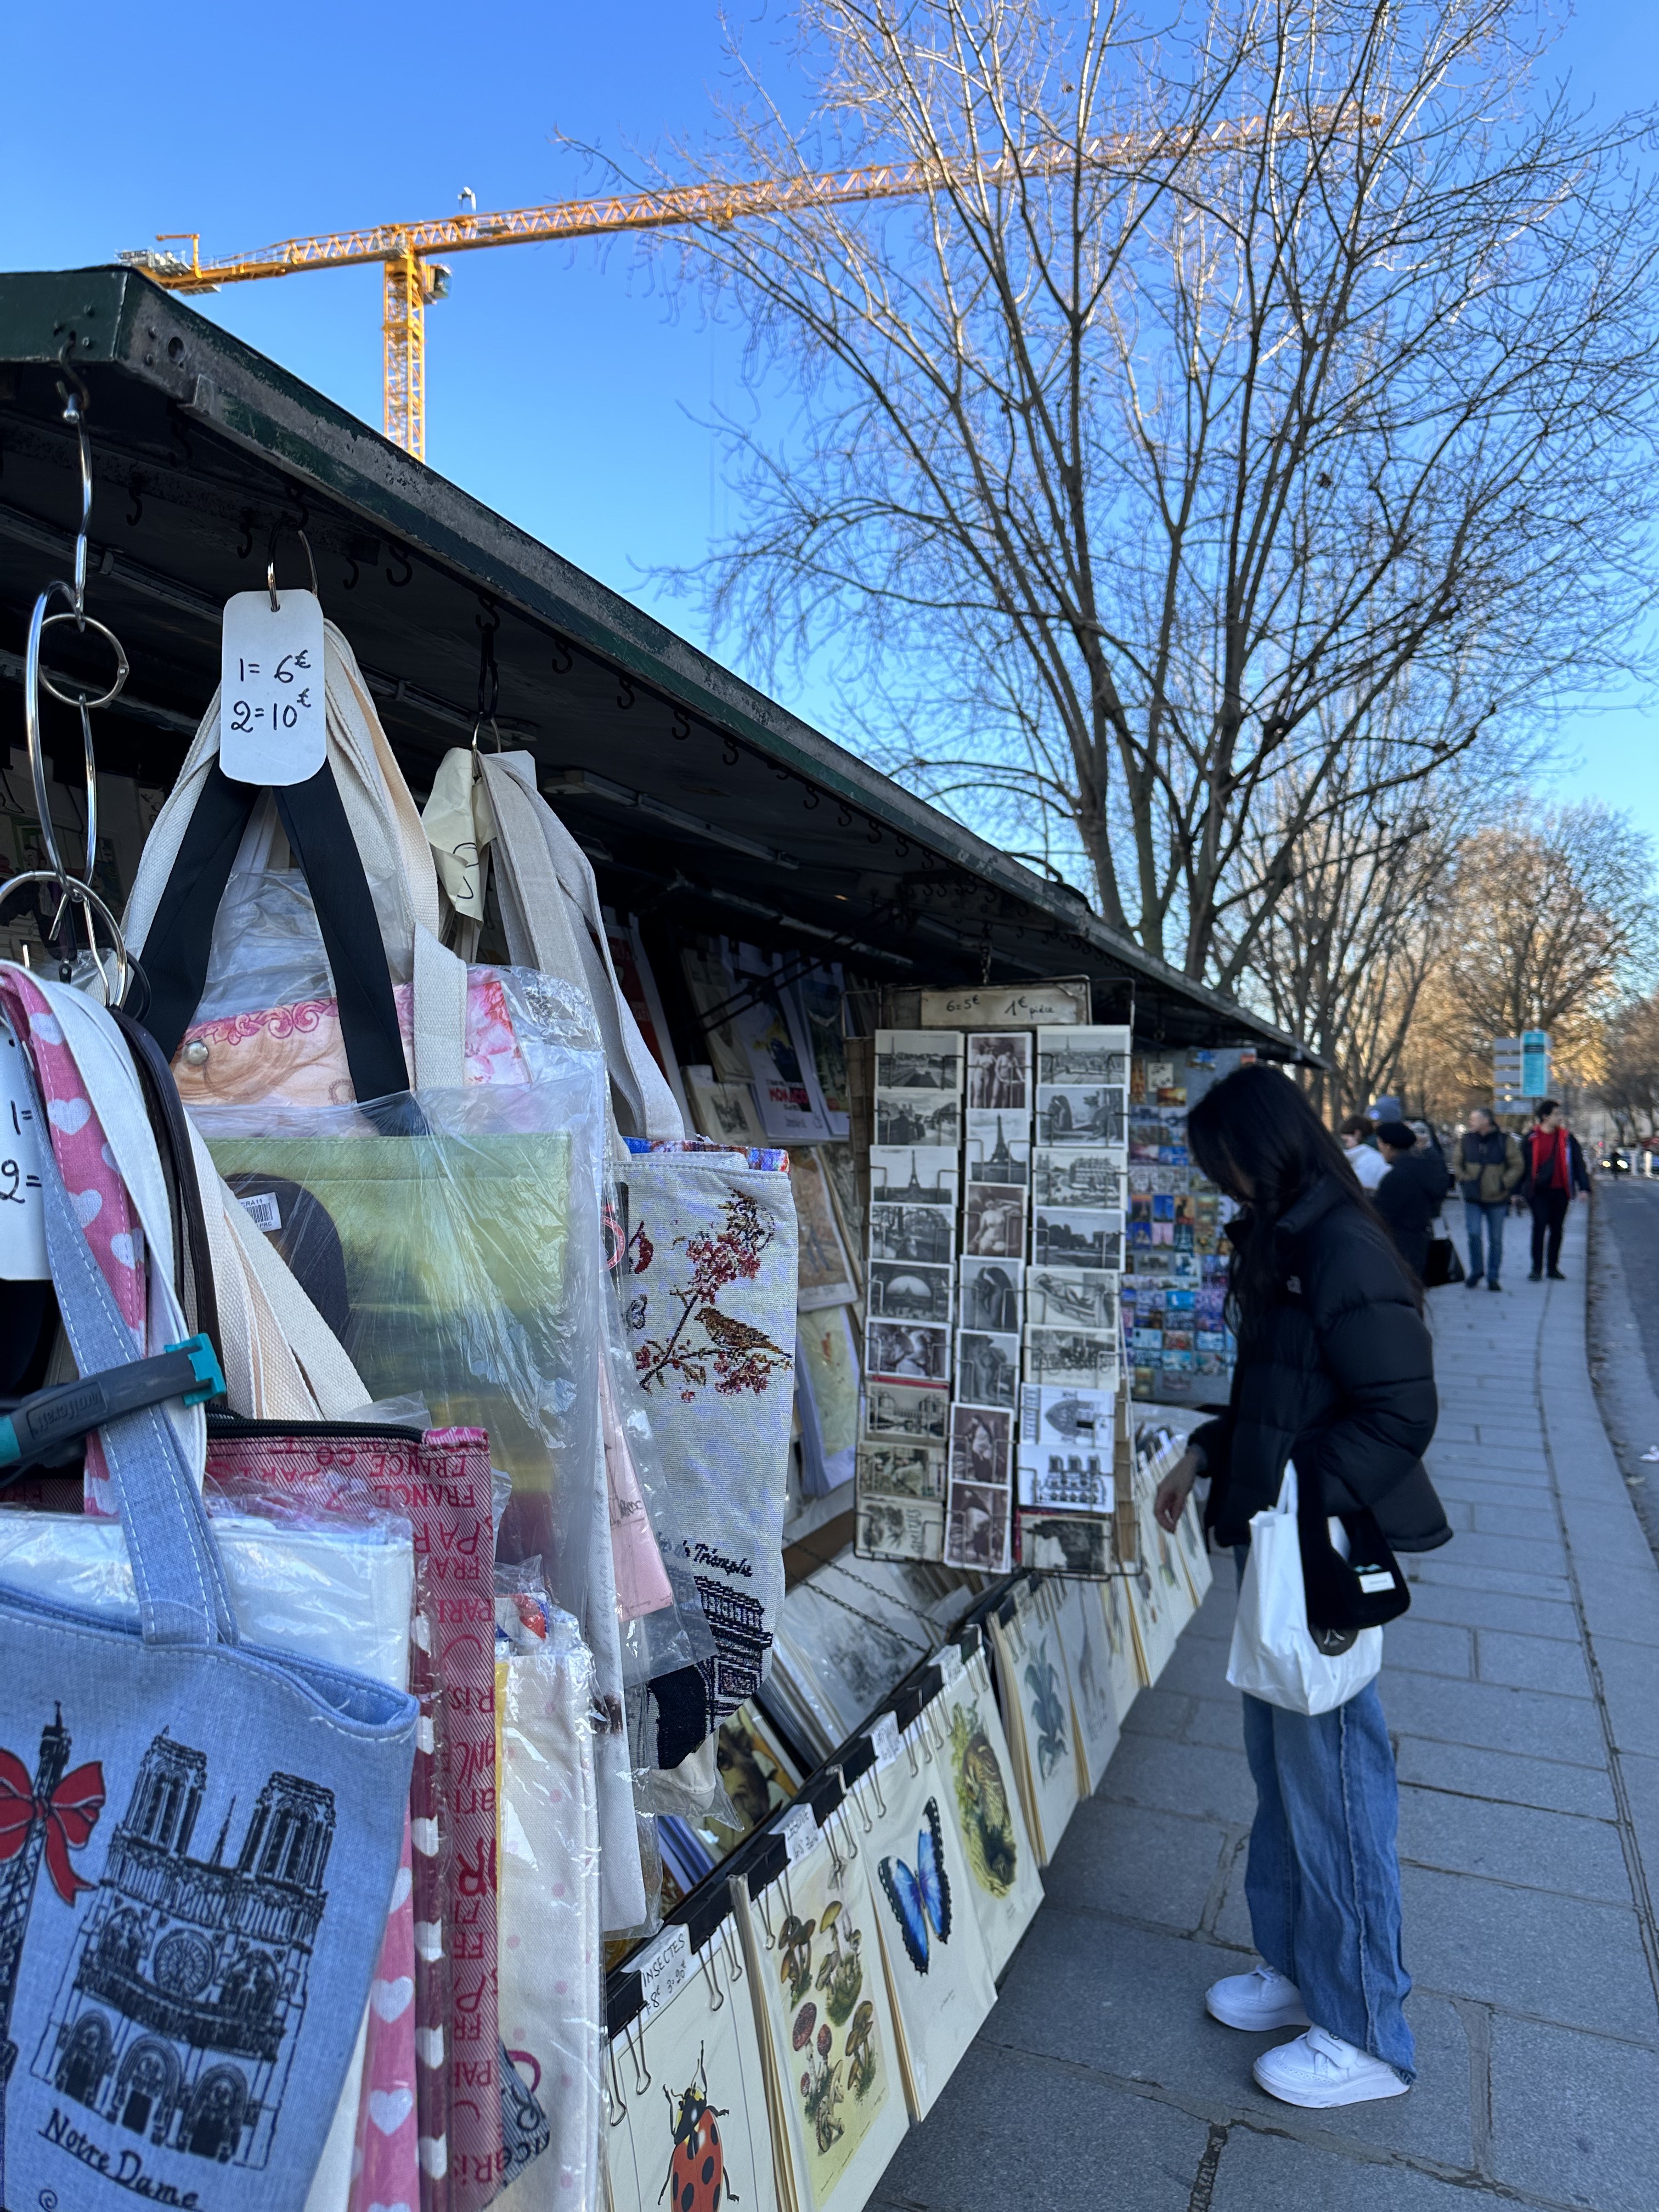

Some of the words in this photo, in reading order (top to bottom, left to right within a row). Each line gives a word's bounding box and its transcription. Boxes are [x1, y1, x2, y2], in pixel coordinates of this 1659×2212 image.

[375, 1485, 476, 1508] FRANCE
[642, 1933, 685, 1988] INSECTES
[44, 2107, 111, 2174] Notre
[112, 2148, 200, 2208] Dame
